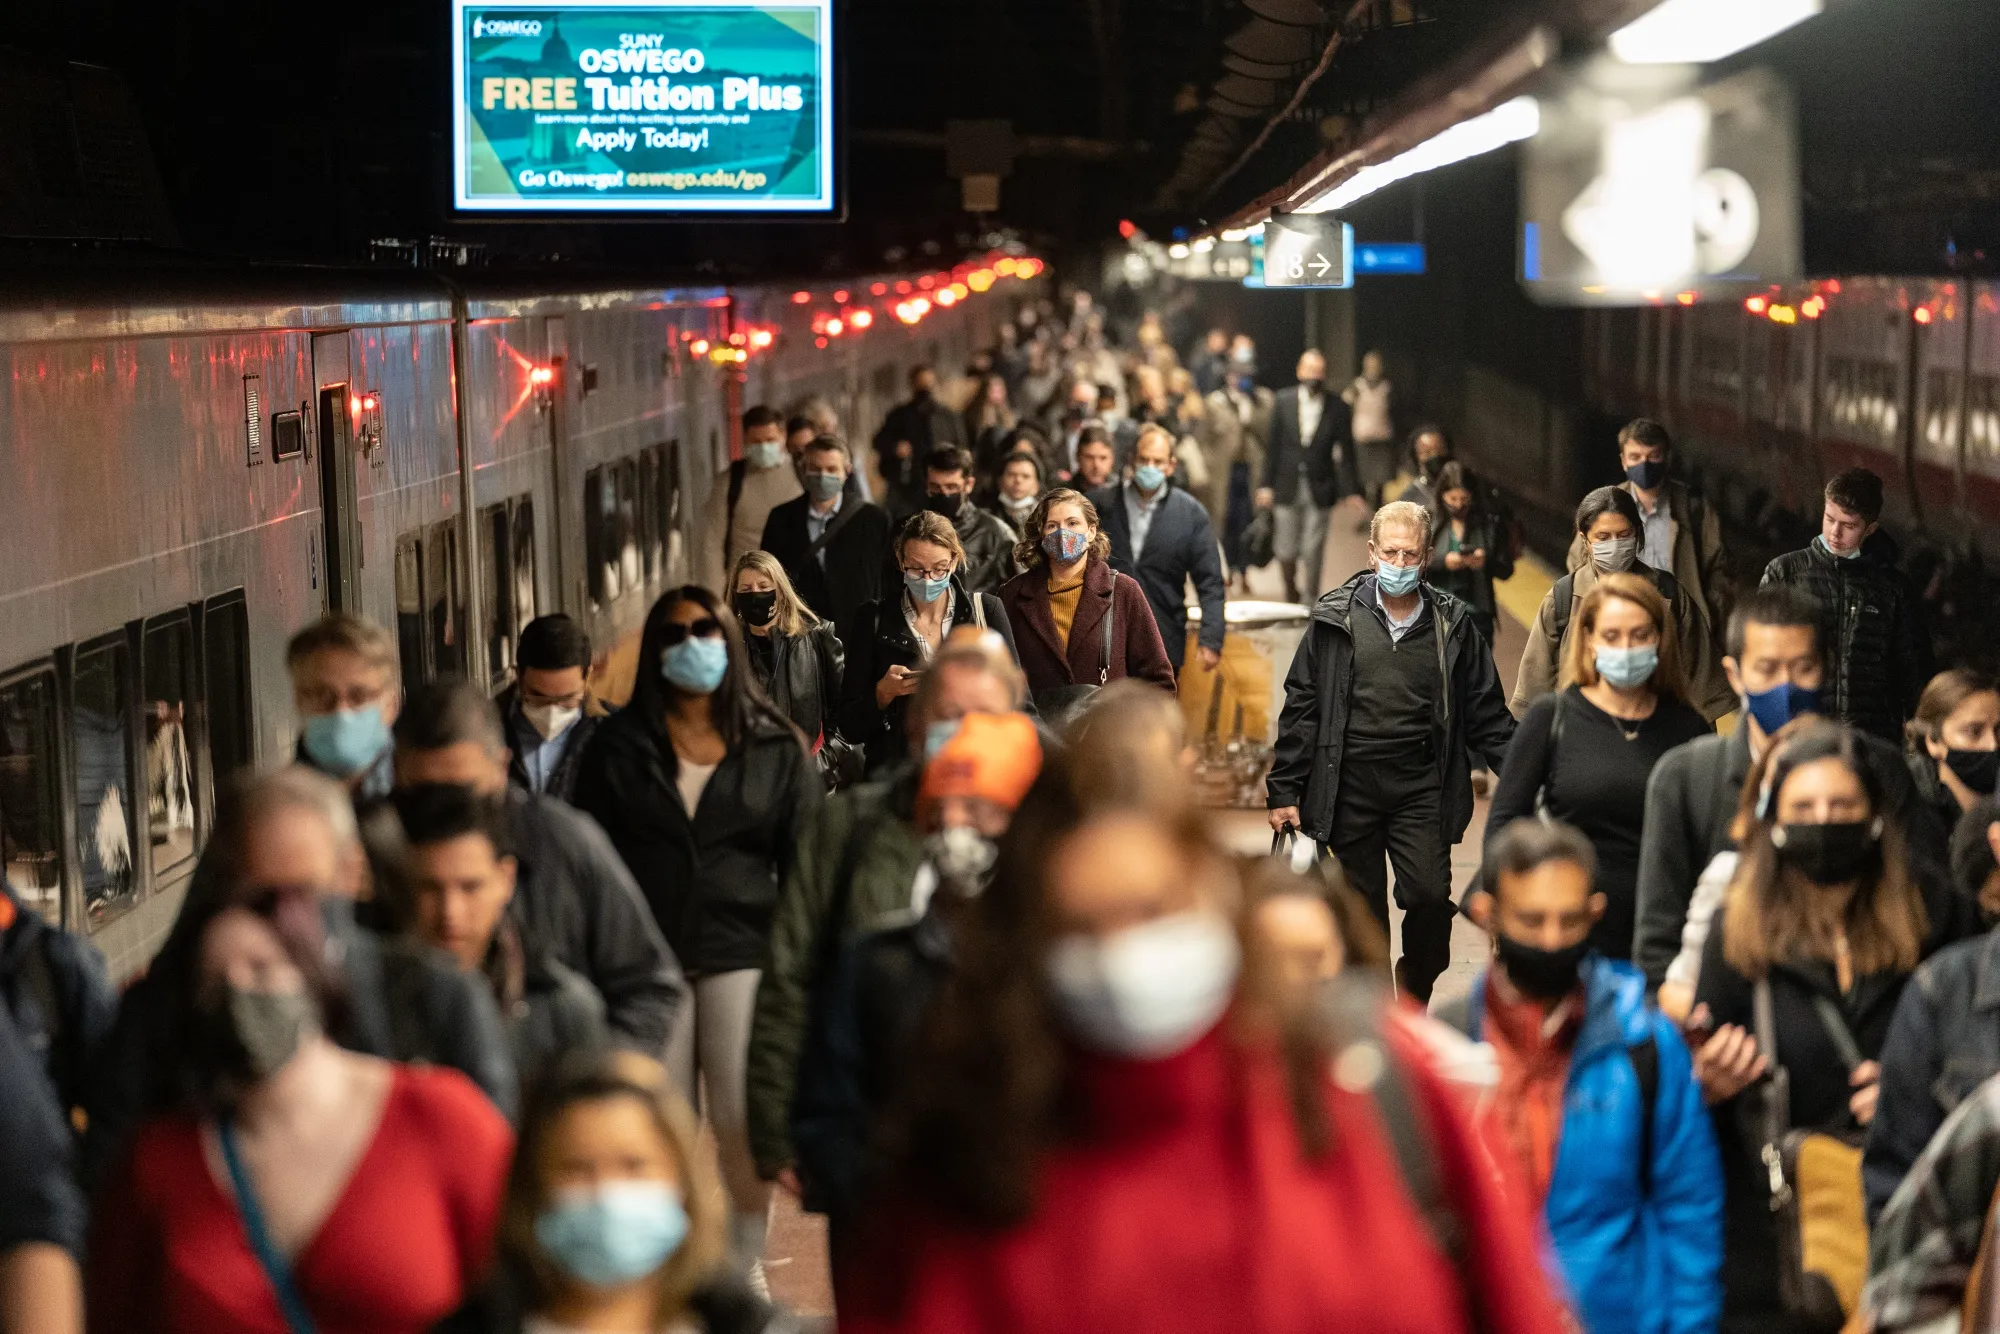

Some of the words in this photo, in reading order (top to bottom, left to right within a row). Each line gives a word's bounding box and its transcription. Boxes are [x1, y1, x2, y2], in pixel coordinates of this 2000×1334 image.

[619, 33, 664, 49] SUNY
[579, 48, 705, 74] OSWEGO
[482, 77, 577, 111] FREE
[584, 76, 715, 111] Tuition
[722, 77, 803, 111] Plus
[575, 127, 637, 152] Apply
[640, 127, 709, 152] Today!
[519, 170, 546, 187] Go
[548, 170, 624, 190] Oswego!
[626, 169, 767, 190] oswego.edu/go
